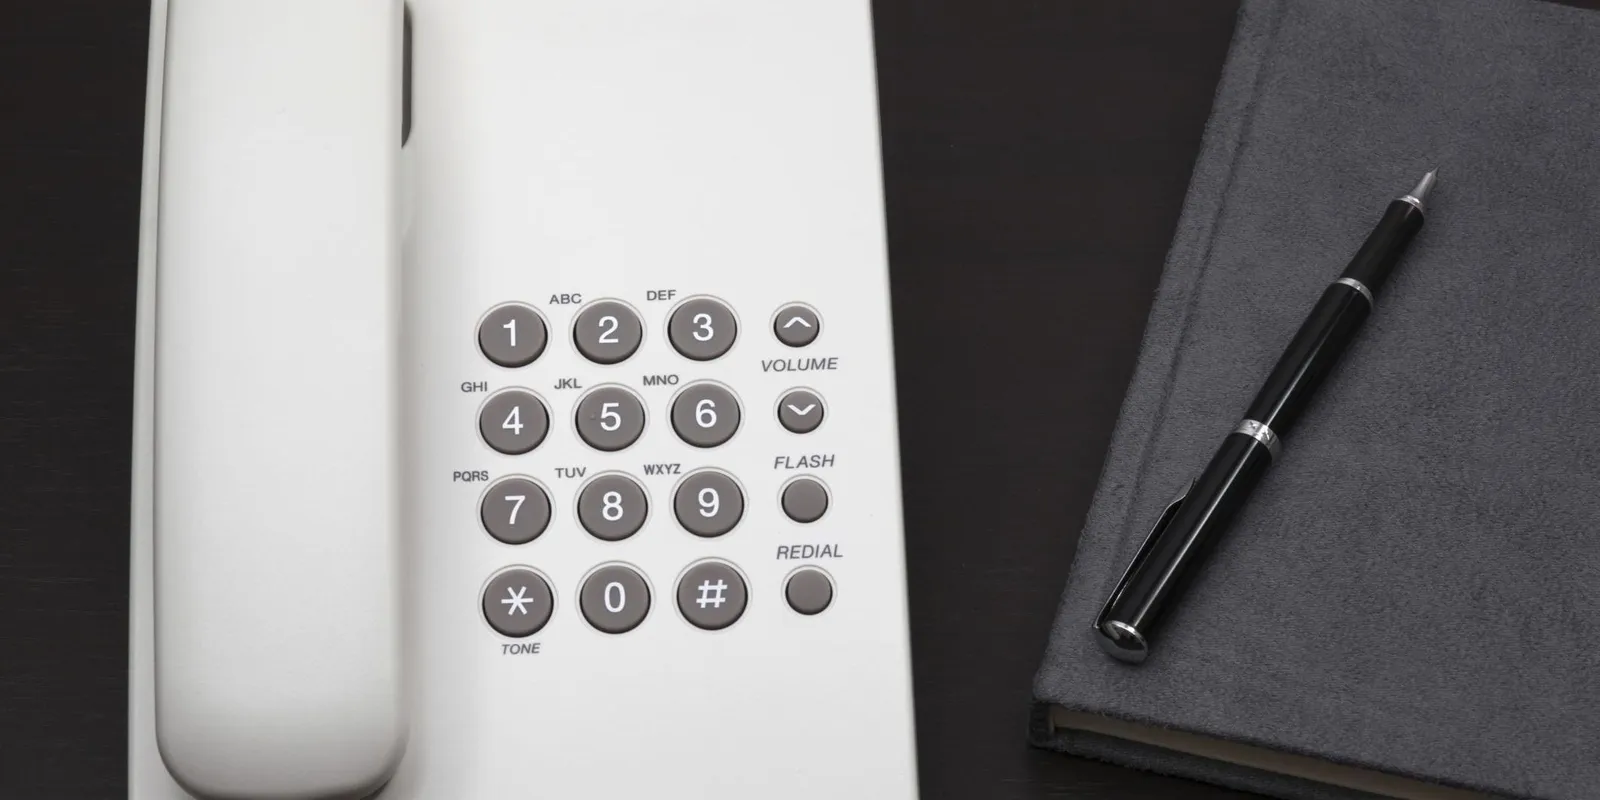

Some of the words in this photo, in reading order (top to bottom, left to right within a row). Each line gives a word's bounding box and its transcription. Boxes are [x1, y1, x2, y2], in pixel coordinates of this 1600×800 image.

[550, 294, 581, 304] ABC
[647, 290, 676, 301] DEF
[503, 319, 515, 346] 1
[599, 316, 618, 343] 2
[693, 314, 713, 341] 3
[762, 358, 838, 372] VOLUME
[461, 381, 487, 392] GHI
[554, 378, 582, 389] JKL
[643, 375, 679, 386] MNO
[502, 406, 523, 434] 4
[601, 403, 621, 431] 5
[696, 399, 716, 427] 6
[774, 454, 834, 469] FLASH
[453, 471, 489, 482] PQRS
[555, 467, 586, 478] TUV
[644, 464, 681, 475] WXYZ
[505, 495, 525, 524] 7
[603, 491, 623, 521] 8
[699, 488, 719, 517] 9
[777, 544, 843, 559] REDIAL
[605, 582, 625, 612] 0
[696, 580, 727, 608] #
[502, 643, 540, 654] TONE
